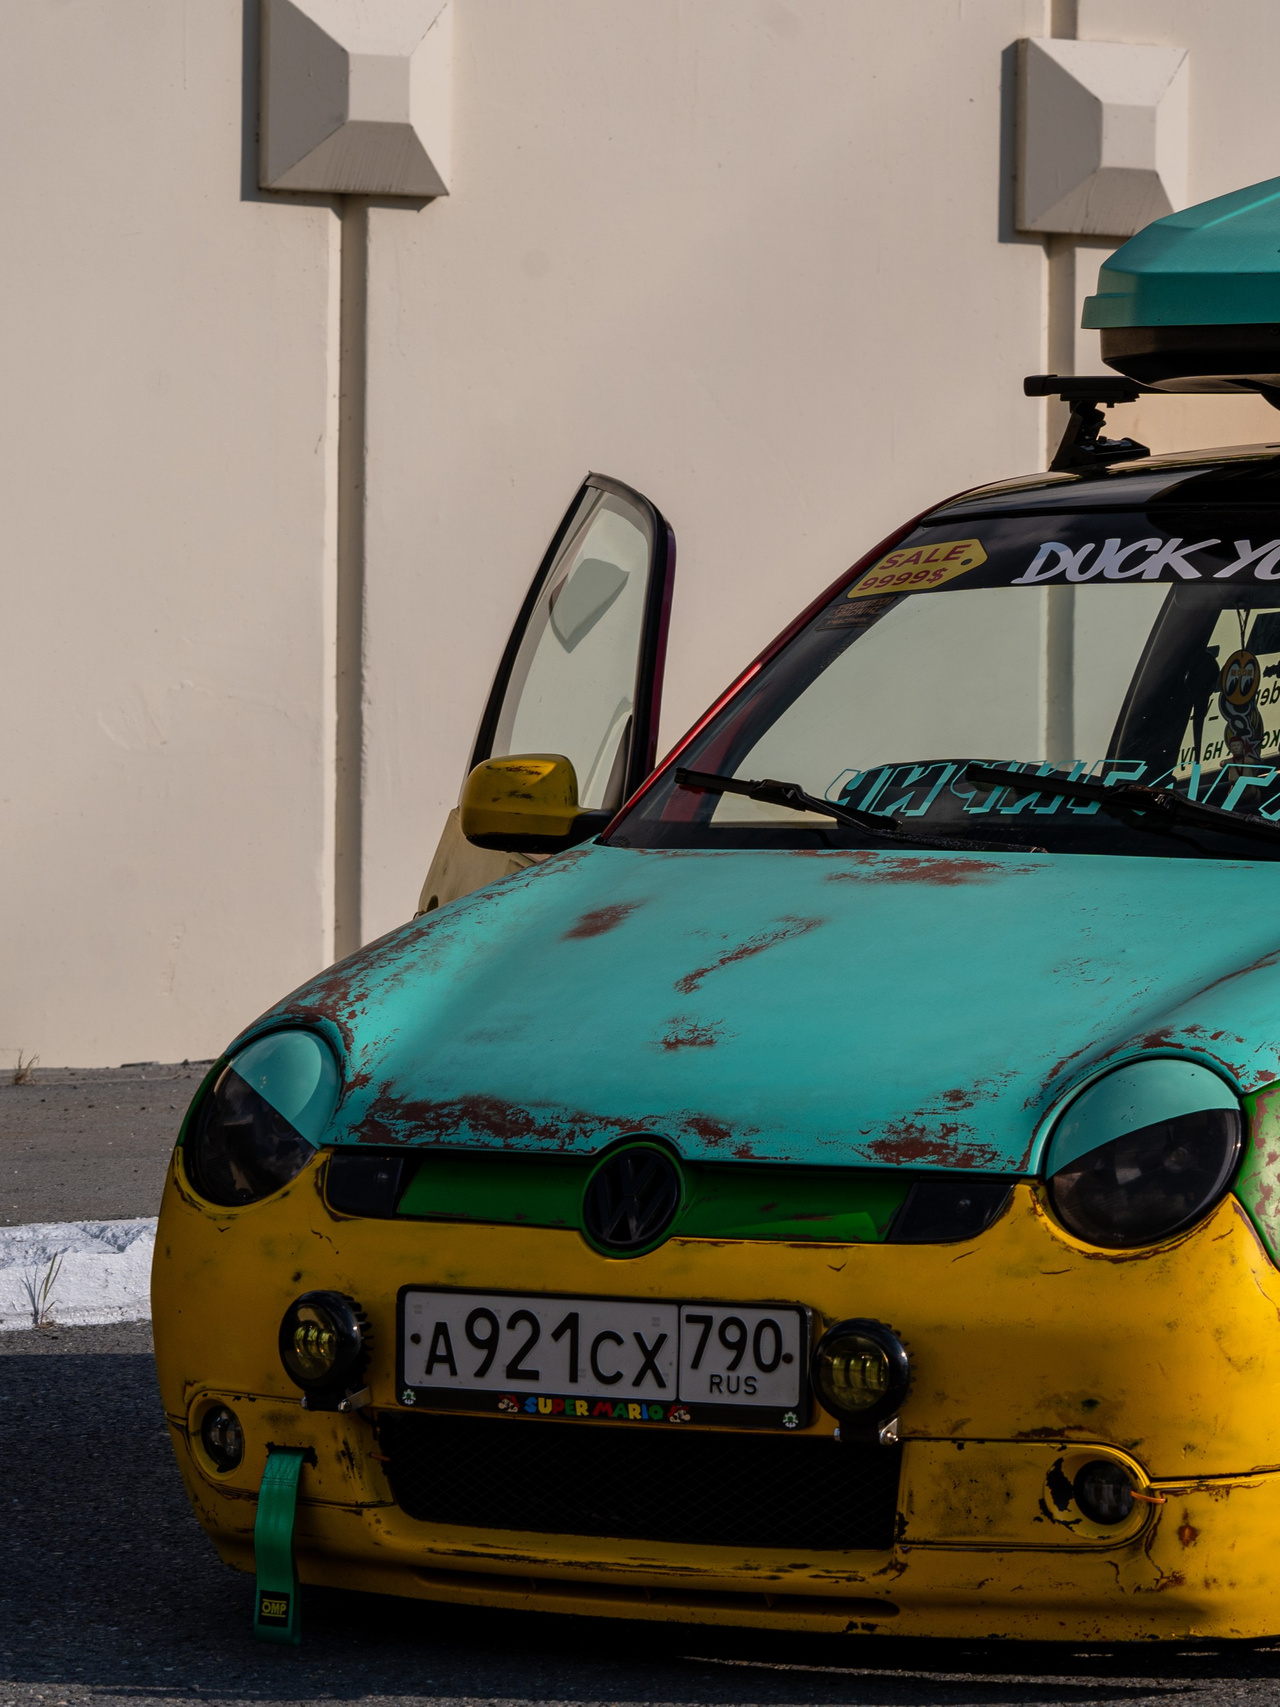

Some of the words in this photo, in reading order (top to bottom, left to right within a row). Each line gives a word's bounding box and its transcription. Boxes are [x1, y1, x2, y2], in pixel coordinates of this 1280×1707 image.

[878, 543, 972, 570] SALE
[1010, 537, 1222, 584] DUCK
[857, 567, 949, 592] 9999$
[684, 1314, 784, 1374] 790
[708, 1373, 758, 1396] RUS
[524, 1396, 590, 1417] SUPER
[592, 1398, 664, 1422] MARIO
[262, 1601, 287, 1615] OMP
